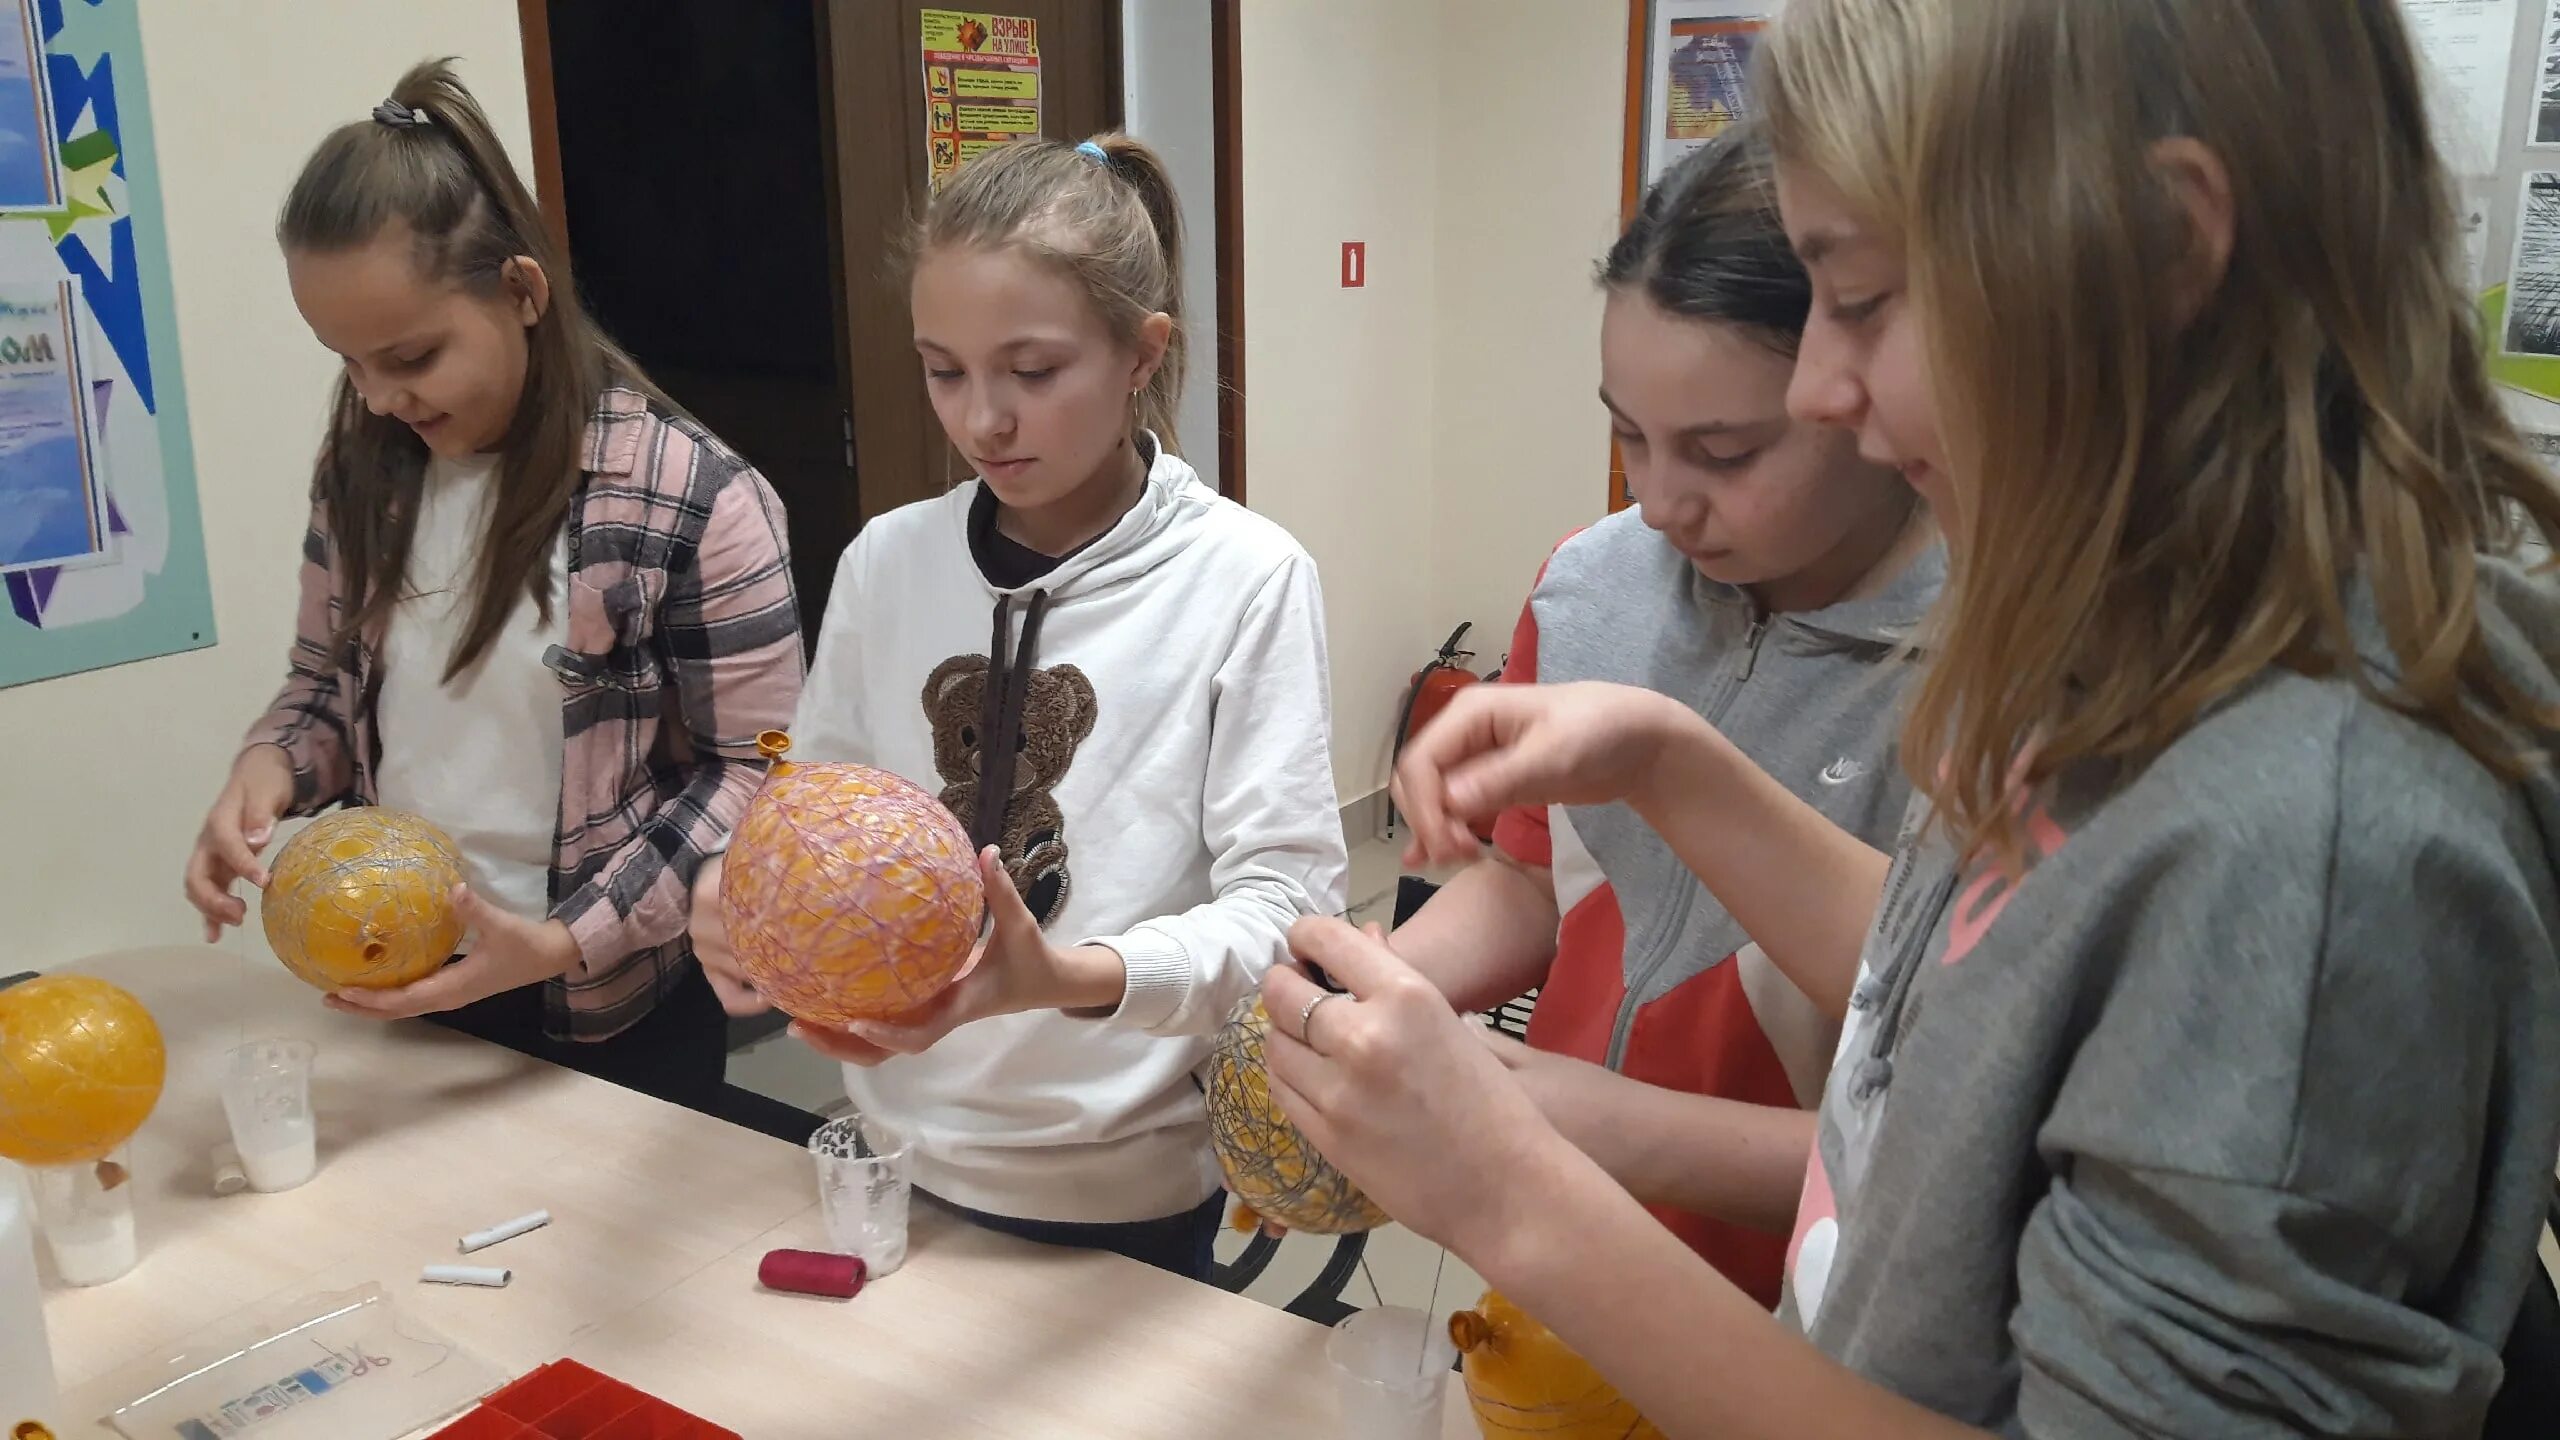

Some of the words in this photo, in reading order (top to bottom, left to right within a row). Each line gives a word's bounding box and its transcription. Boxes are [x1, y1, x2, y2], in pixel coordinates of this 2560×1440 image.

[992, 17, 1029, 38] ВЗРЫВ
[992, 38, 1003, 53] НА
[1004, 39, 1029, 55] УЛИЦЕ
